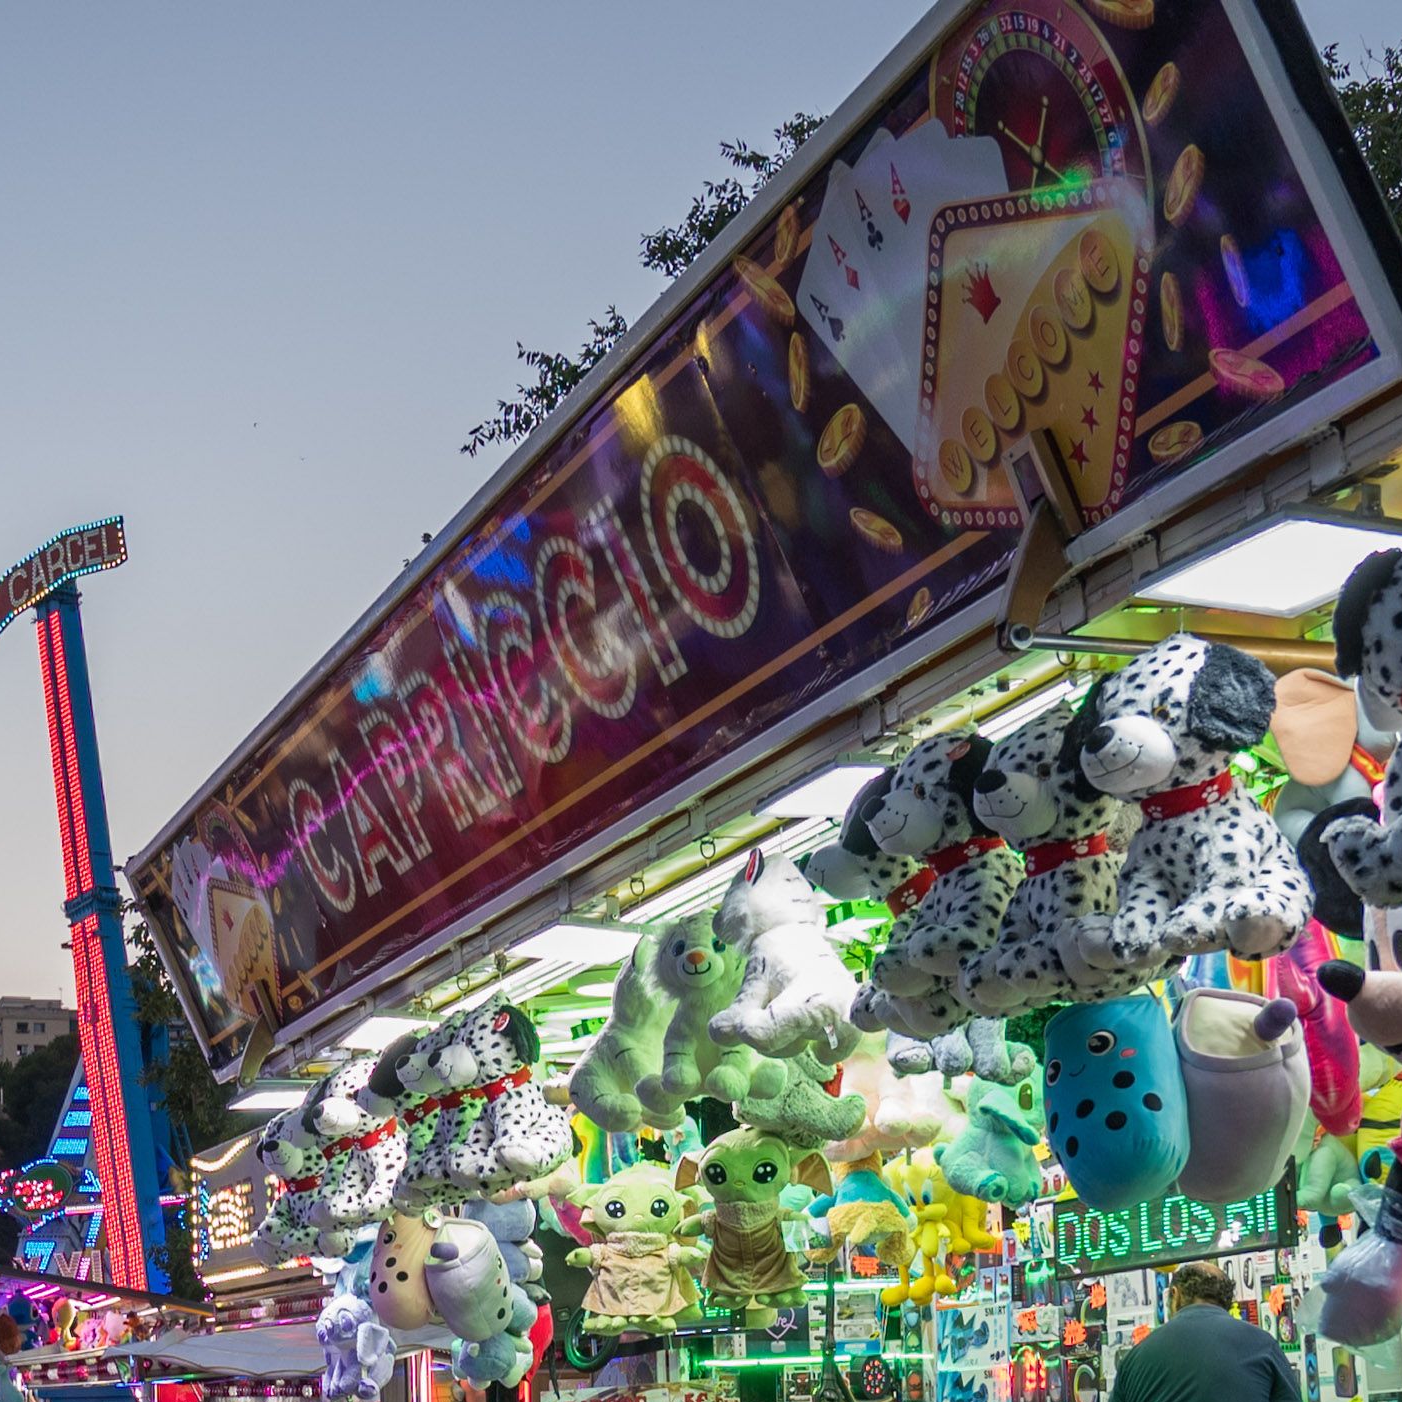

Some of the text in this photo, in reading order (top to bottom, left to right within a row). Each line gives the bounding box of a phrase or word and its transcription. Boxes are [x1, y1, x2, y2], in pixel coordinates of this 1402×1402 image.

[1000, 16, 1012, 31] 32
[1013, 15, 1025, 30] 15
[1027, 17, 1039, 33] 19
[1054, 32, 1066, 50] 21
[1069, 51, 1078, 63] 2
[943, 244, 1110, 480] WELCOME
[8, 527, 121, 607] CARCEL
[287, 434, 759, 913] CAPRICCIO
[1140, 1195, 1216, 1251] LOS
